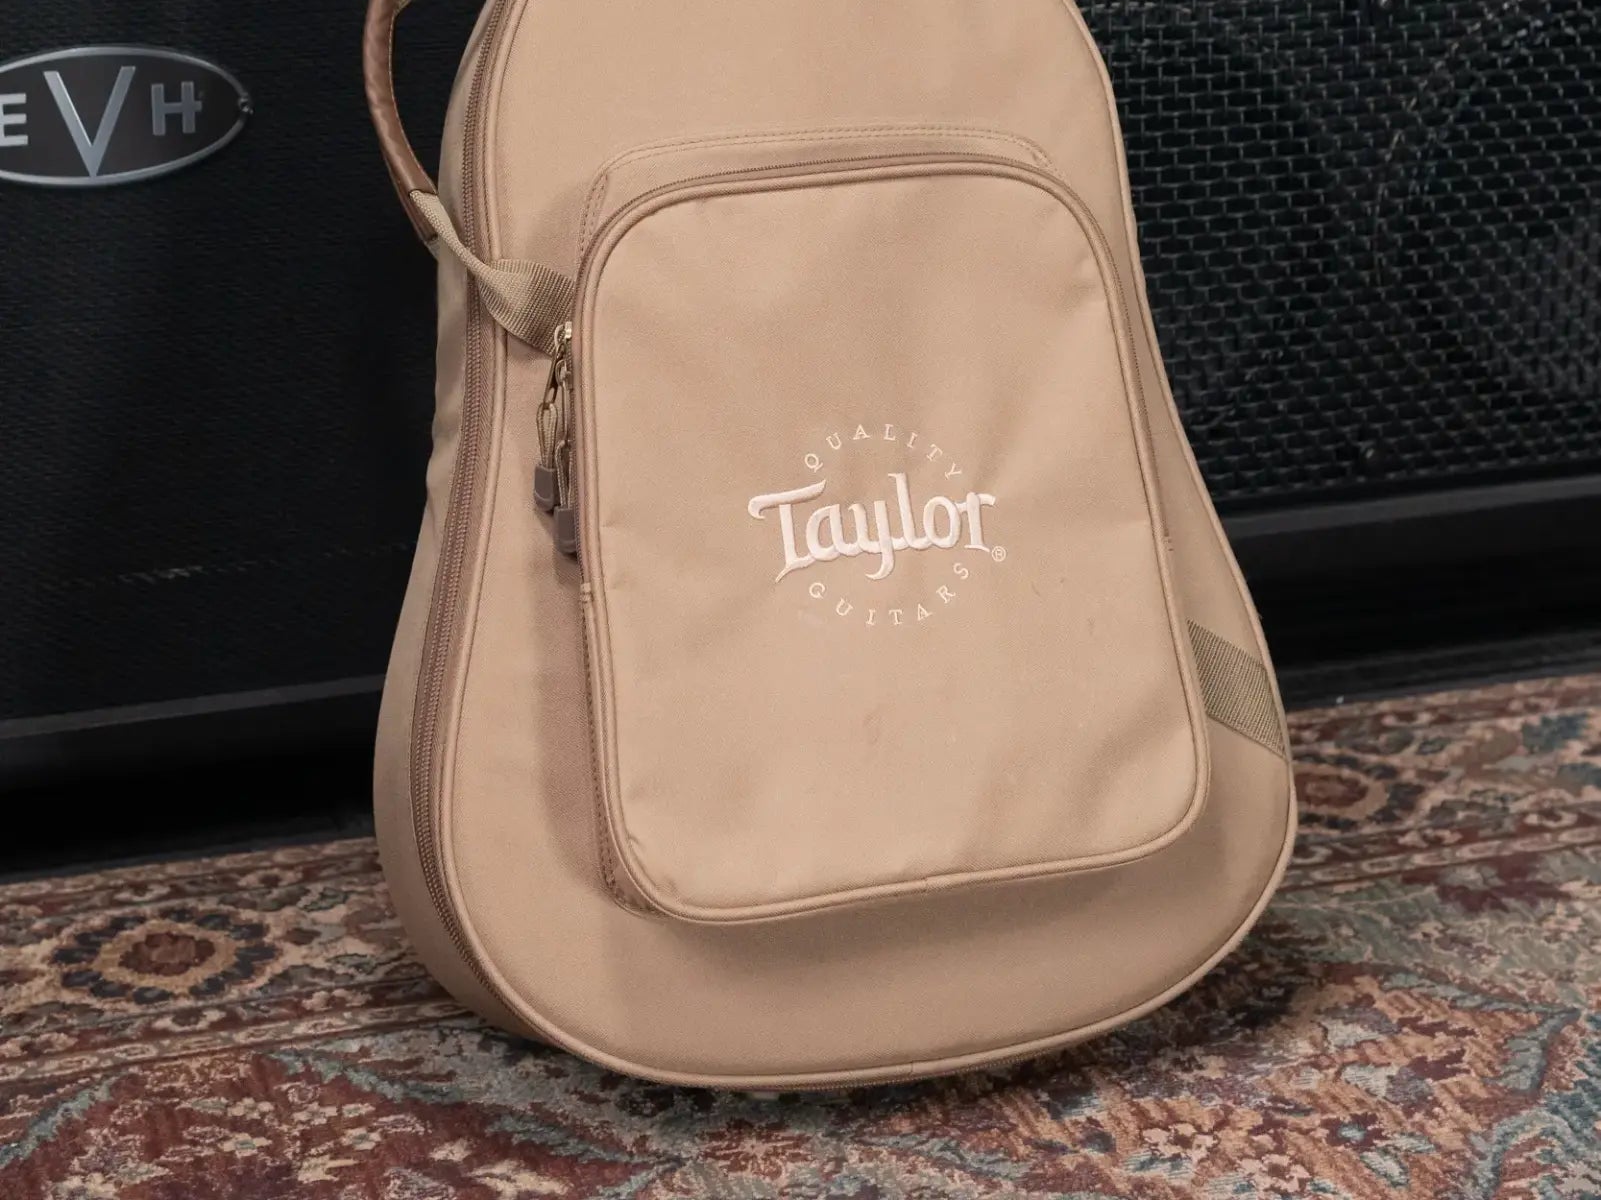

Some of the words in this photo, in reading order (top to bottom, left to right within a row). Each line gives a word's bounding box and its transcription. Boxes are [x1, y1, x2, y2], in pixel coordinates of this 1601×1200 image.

[0, 65, 203, 178] EVH
[804, 423, 962, 480] QUALITY
[747, 472, 996, 583] Taylor
[808, 562, 970, 626] GUITARS
